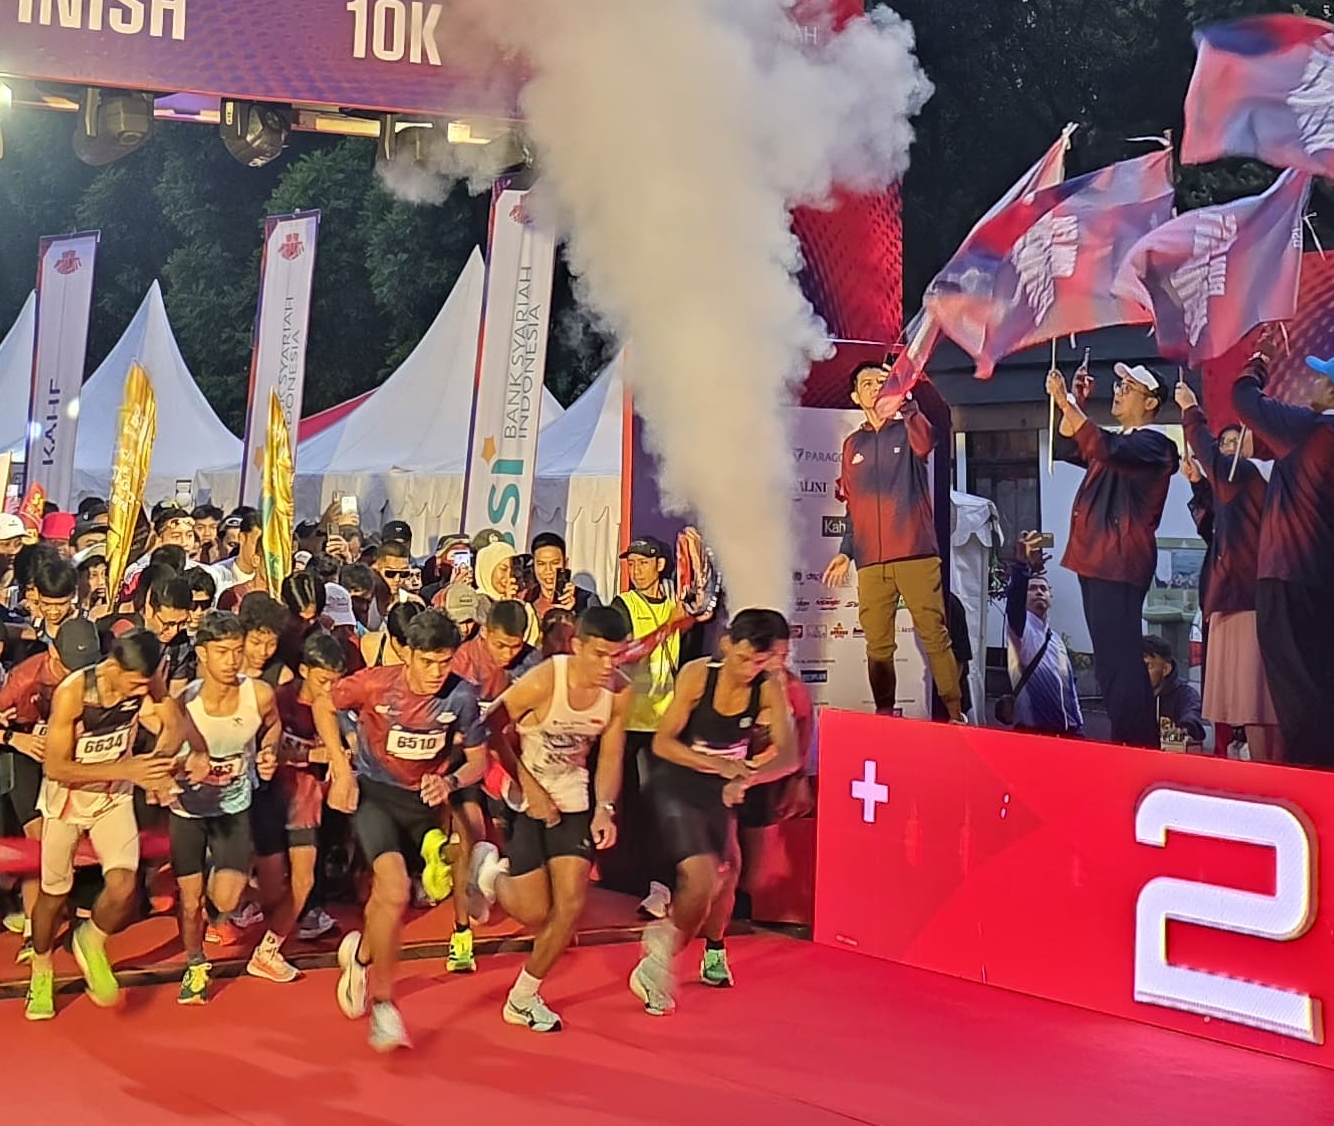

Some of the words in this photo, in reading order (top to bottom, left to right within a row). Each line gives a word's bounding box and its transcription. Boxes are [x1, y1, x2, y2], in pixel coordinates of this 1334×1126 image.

[278, 297, 294, 386] SYARIAH
[511, 266, 532, 367] SYARIAH
[283, 330, 300, 429] DONESIA
[505, 371, 523, 439] BANK
[519, 304, 542, 438] INDONESIA
[805, 452, 843, 462] PARAGO
[487, 459, 525, 554] SI
[825, 519, 845, 534] Kah
[84, 735, 124, 753] 6634
[1134, 786, 1323, 1045] 2
